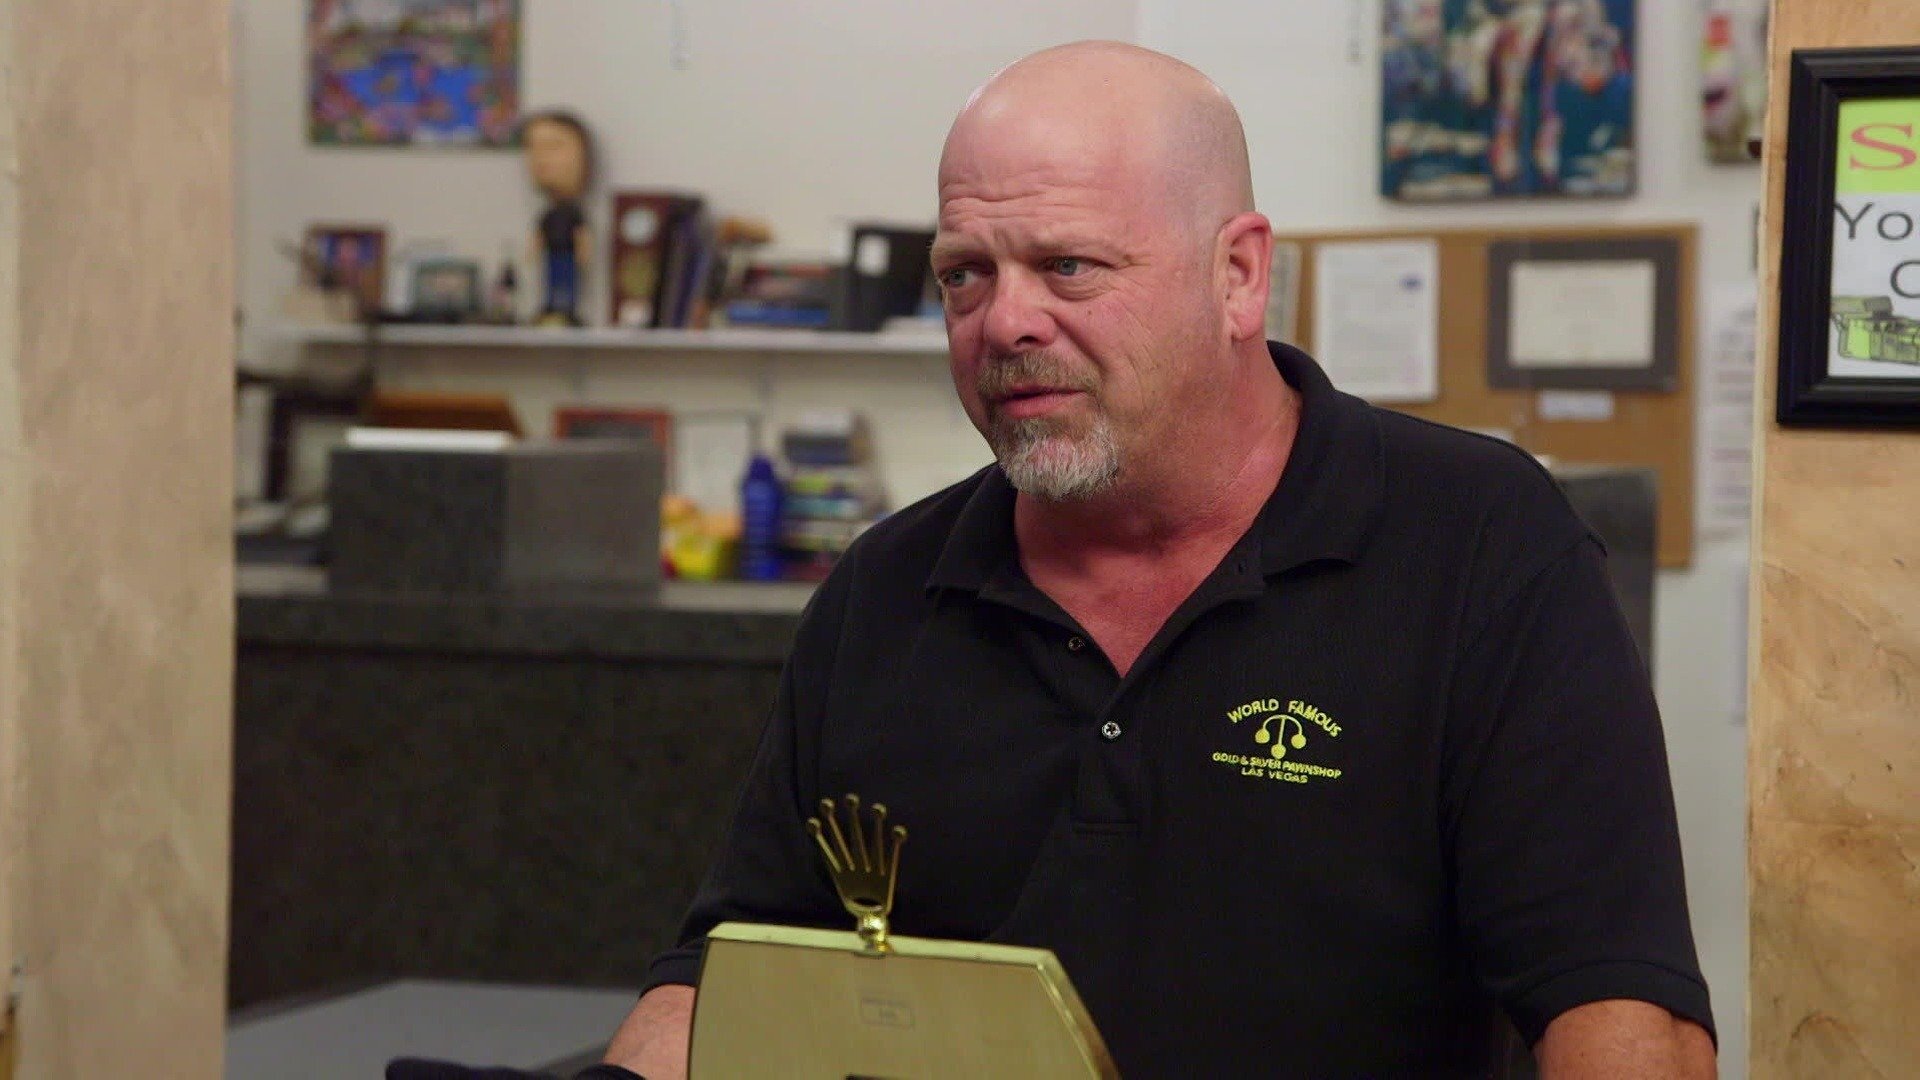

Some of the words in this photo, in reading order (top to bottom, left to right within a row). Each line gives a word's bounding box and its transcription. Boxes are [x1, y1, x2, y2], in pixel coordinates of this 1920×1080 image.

[1227, 699, 1279, 723] WORLD
[1288, 700, 1342, 737] FAMOUS
[1212, 752, 1239, 764] GOLD
[1240, 755, 1249, 765] &
[1250, 757, 1281, 769] SILVER
[1282, 761, 1342, 779] PAWNSHOP
[1241, 767, 1264, 777] LAS
[1268, 770, 1308, 783] VEGAS
